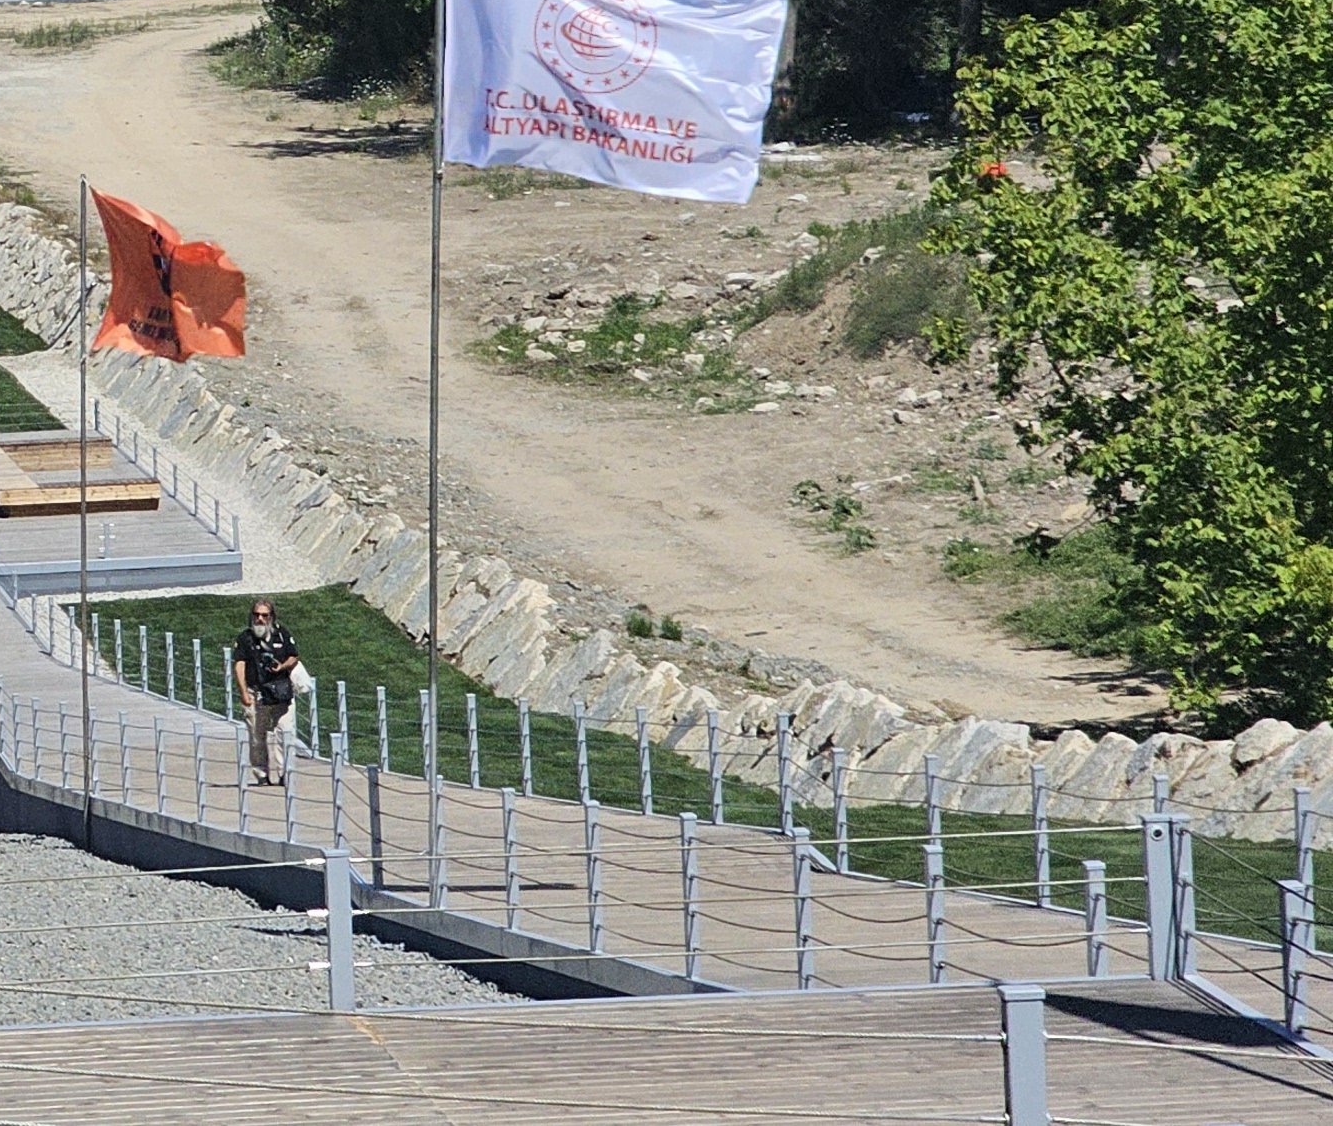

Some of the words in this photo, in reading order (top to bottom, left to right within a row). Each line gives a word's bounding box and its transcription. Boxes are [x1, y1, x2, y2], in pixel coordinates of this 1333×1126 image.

[523, 92, 660, 135] ULAŞTIRMA
[667, 117, 699, 140] VE
[572, 126, 694, 164] BAKANLIĞI
